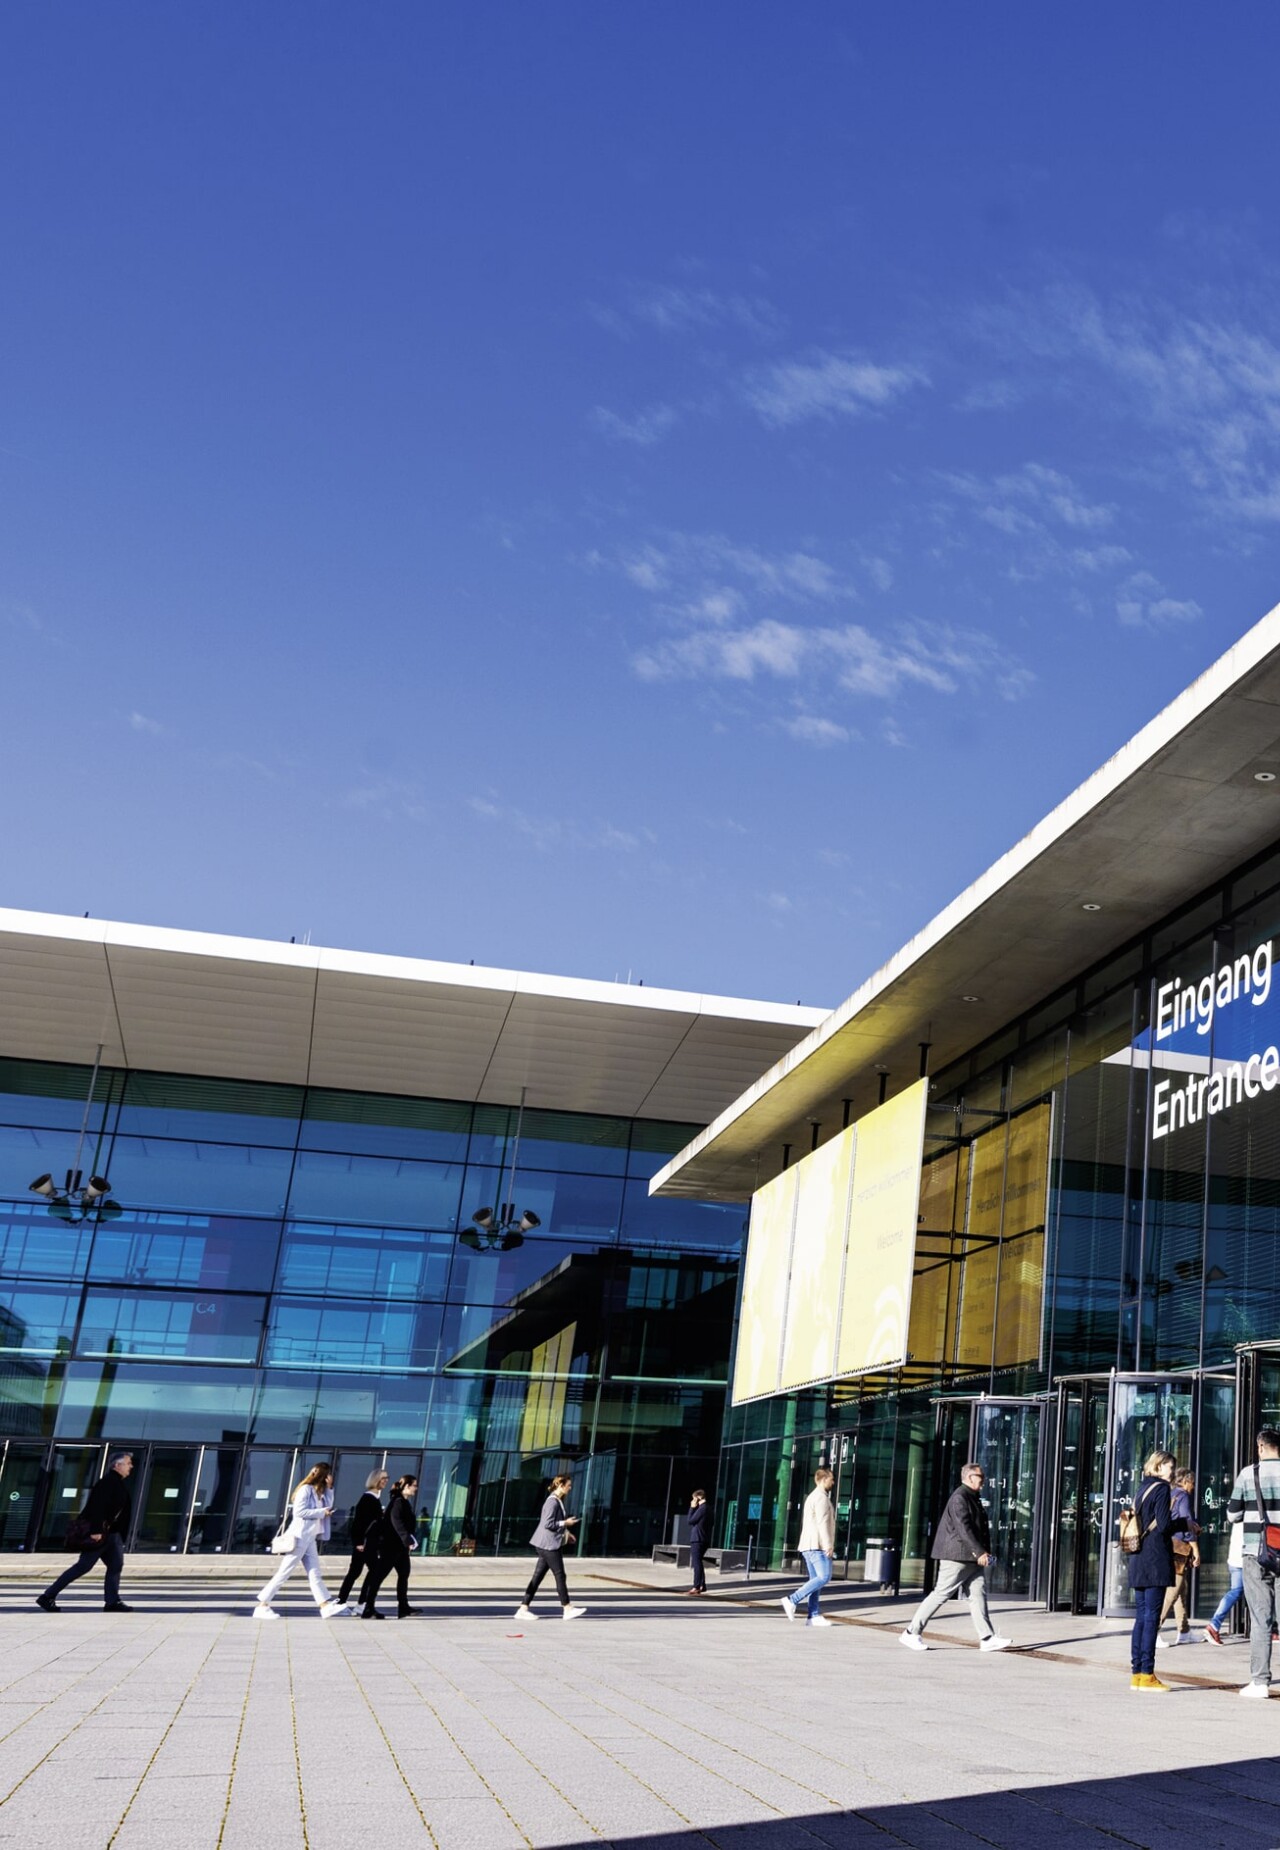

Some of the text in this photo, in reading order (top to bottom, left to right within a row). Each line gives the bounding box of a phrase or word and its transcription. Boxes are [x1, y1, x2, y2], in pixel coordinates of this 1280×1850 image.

[1156, 940, 1272, 1042] Eingang
[1152, 1045, 1280, 1140] Entrance
[196, 1302, 216, 1314] C4
